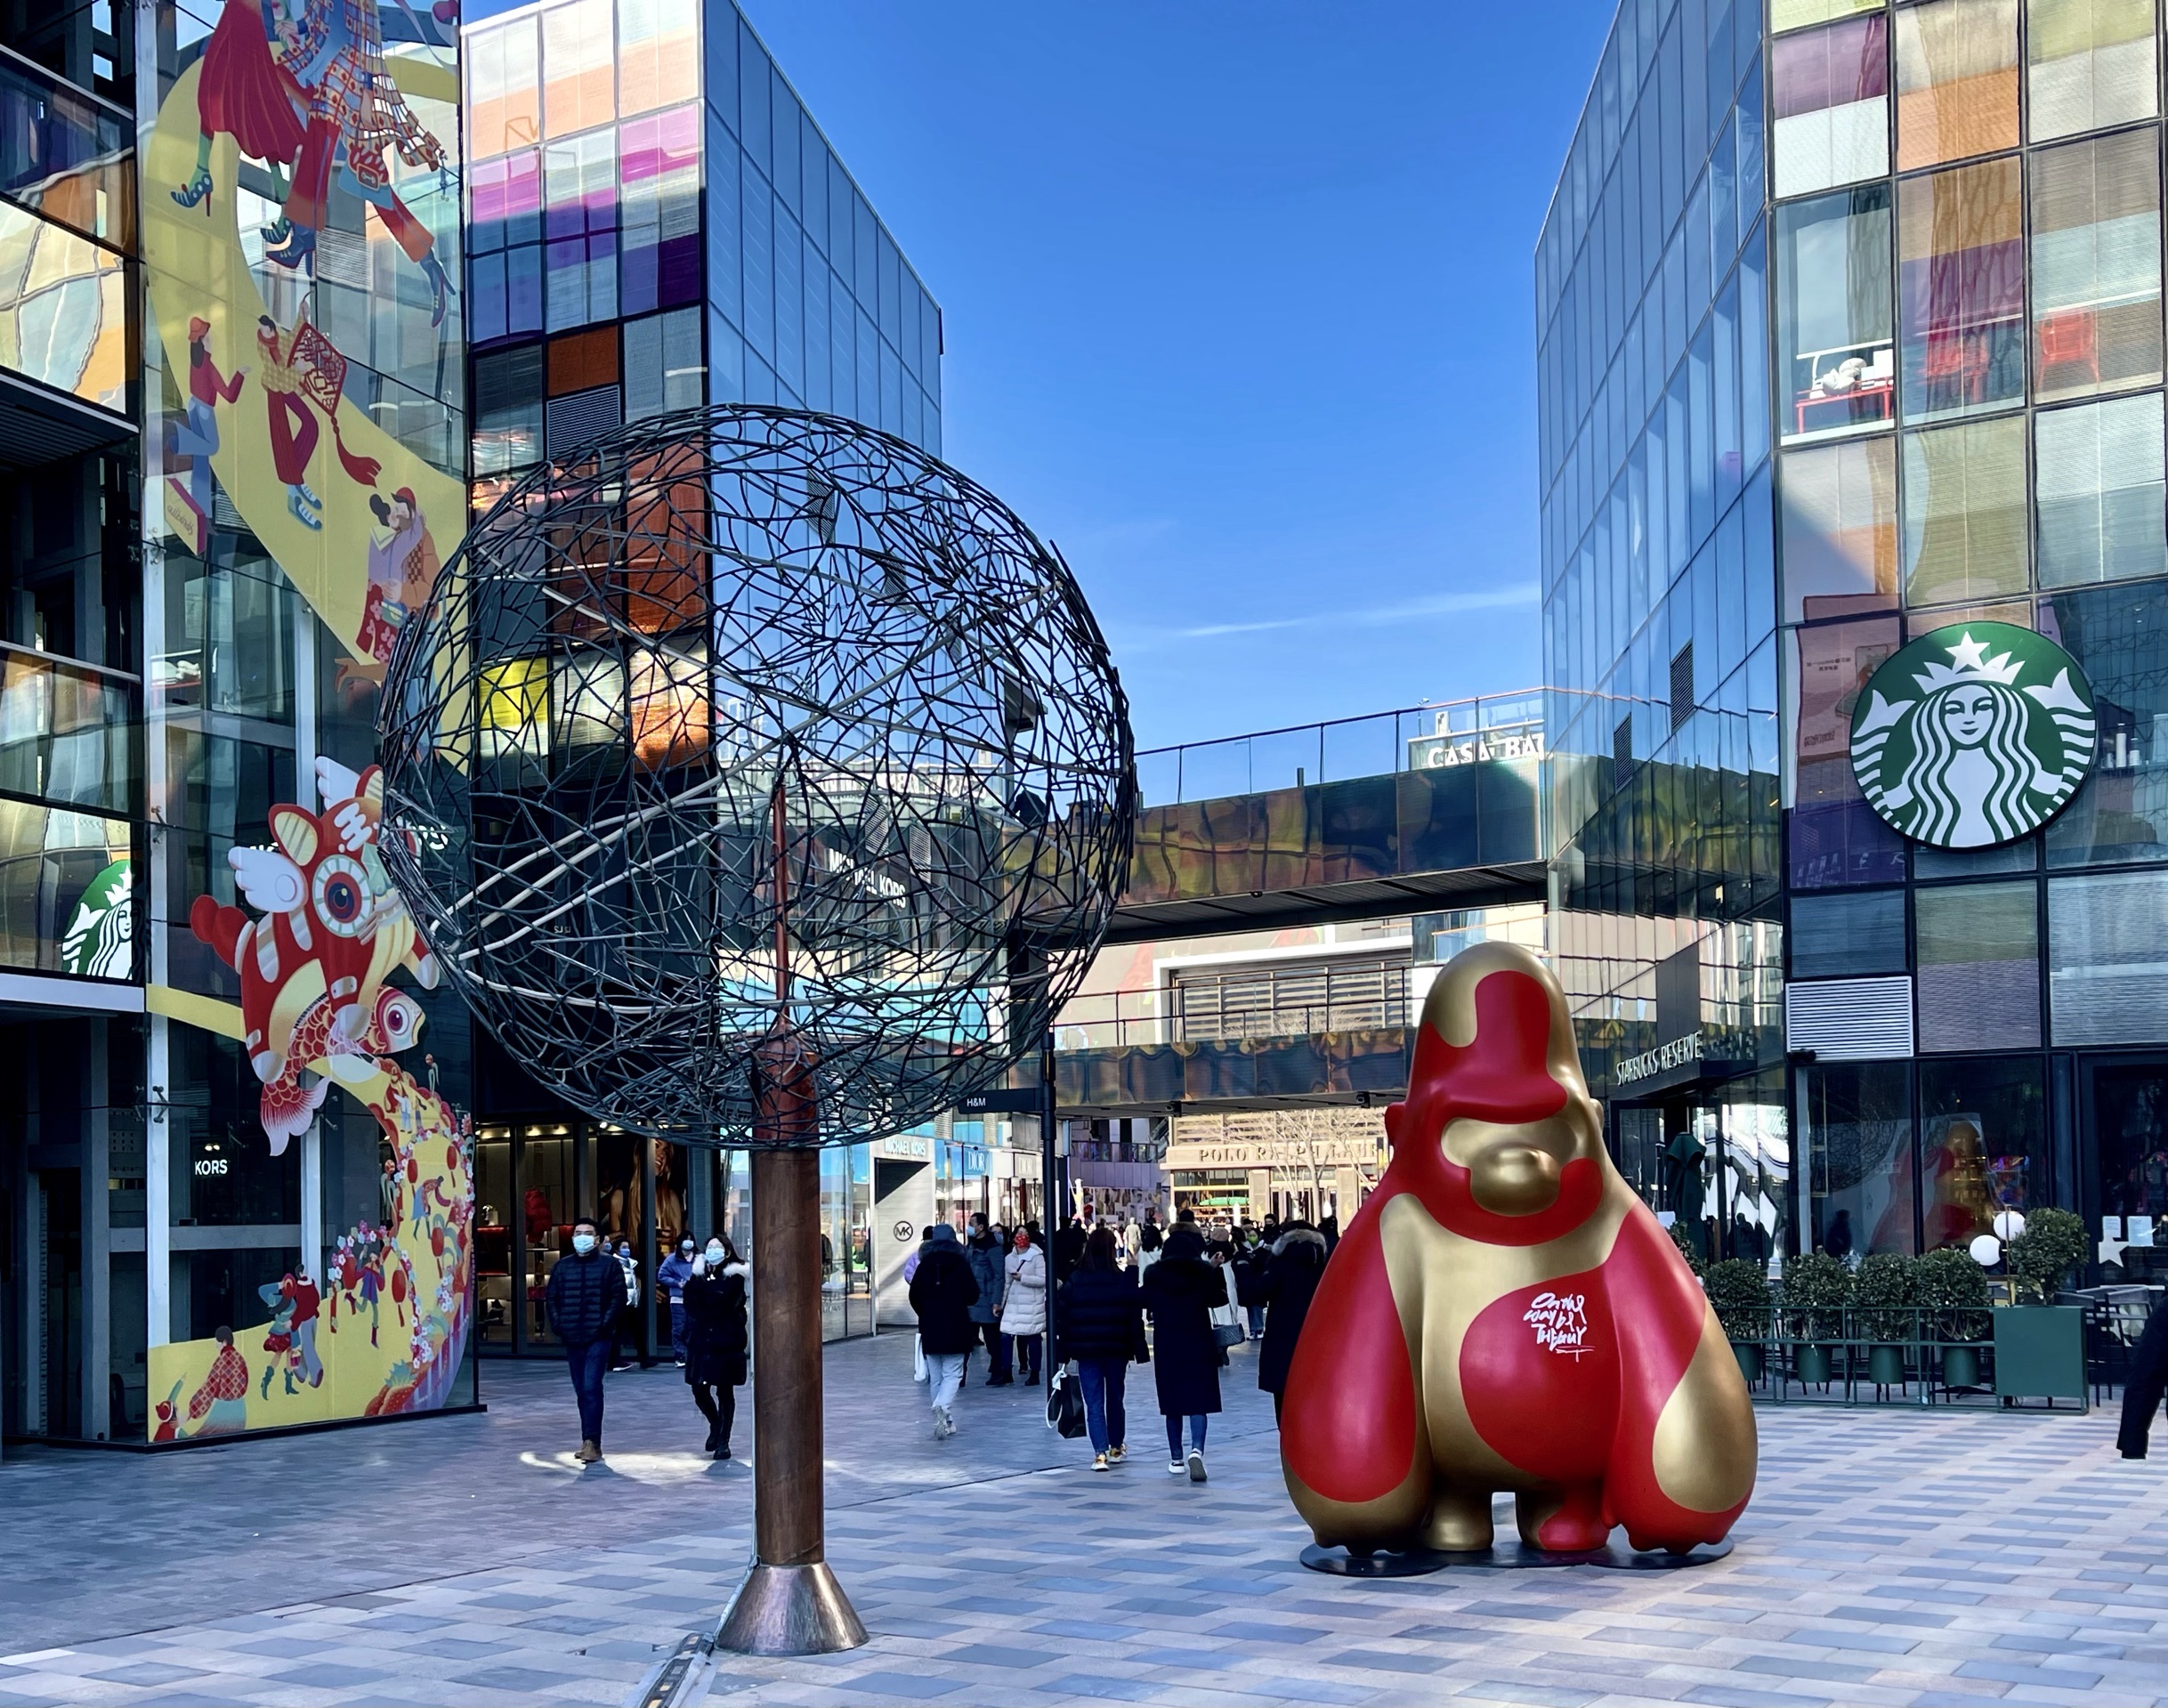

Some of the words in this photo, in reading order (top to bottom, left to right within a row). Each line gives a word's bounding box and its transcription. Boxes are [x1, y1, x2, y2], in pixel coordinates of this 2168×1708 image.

[1428, 740, 1491, 768] CASA
[879, 874, 906, 908] KORS
[1616, 1048, 1659, 1086] STARBUCKS
[1661, 1030, 1703, 1070] RESERVE
[967, 1097, 986, 1106] H&M
[885, 1137, 910, 1154] MICHAEL
[910, 1141, 926, 1156] KORS
[1199, 1147, 1247, 1162] POLO
[1258, 1145, 1320, 1161] RALPH
[195, 1159, 228, 1176] KORS
[967, 1151, 985, 1171] DIOR
[1018, 1156, 1033, 1175] DIOR
[1531, 1292, 1560, 1309] On
[1523, 1309, 1557, 1326] way
